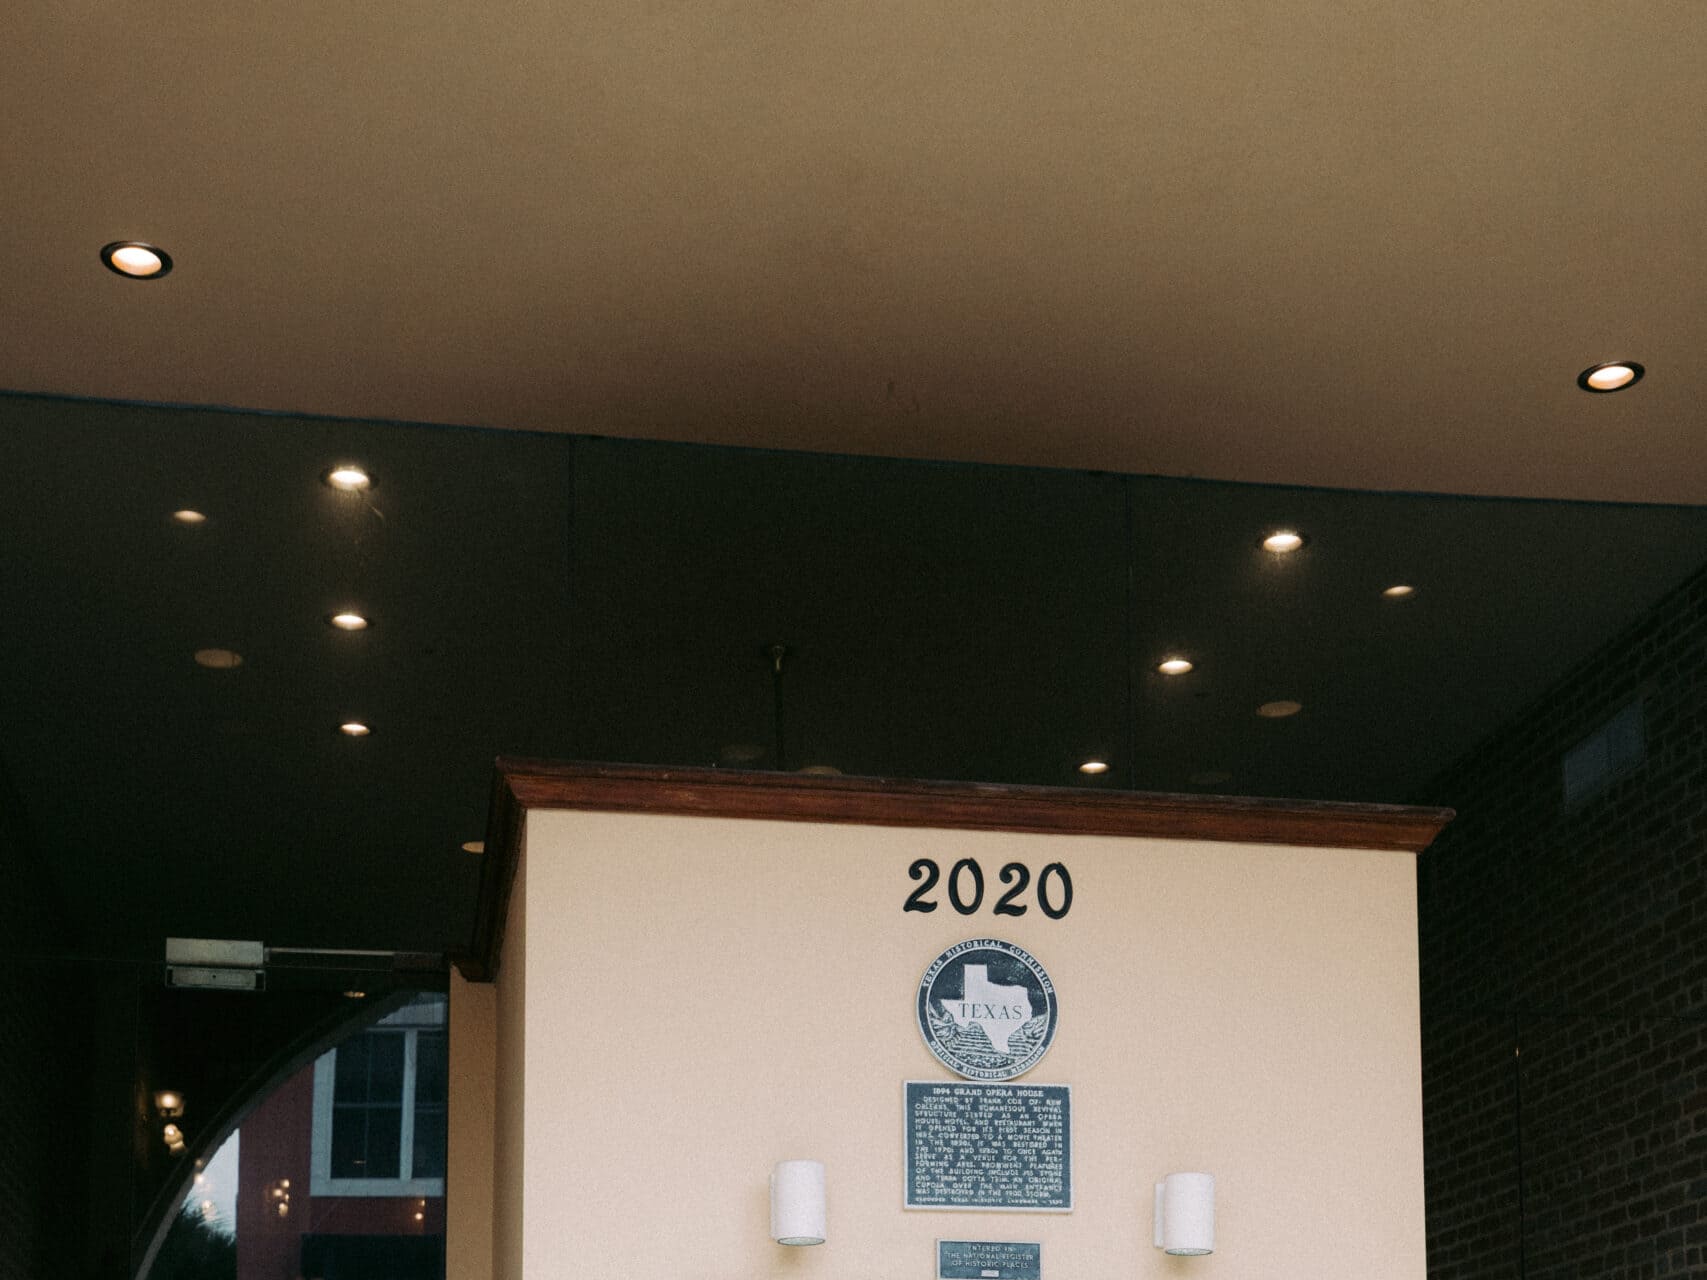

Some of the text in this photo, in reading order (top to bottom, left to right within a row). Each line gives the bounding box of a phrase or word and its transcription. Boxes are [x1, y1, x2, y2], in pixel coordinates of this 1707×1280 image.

[903, 857, 1073, 920] 2020
[922, 940, 1054, 994] TEXAS HISTORICAL COMMISSION
[958, 1003, 1023, 1020] TEXAS
[954, 1088, 982, 1096] GRAND
[986, 1089, 1013, 1097] OPERA
[963, 1252, 1001, 1260] NATIONAL
[965, 1260, 999, 1268] HISTORIC
